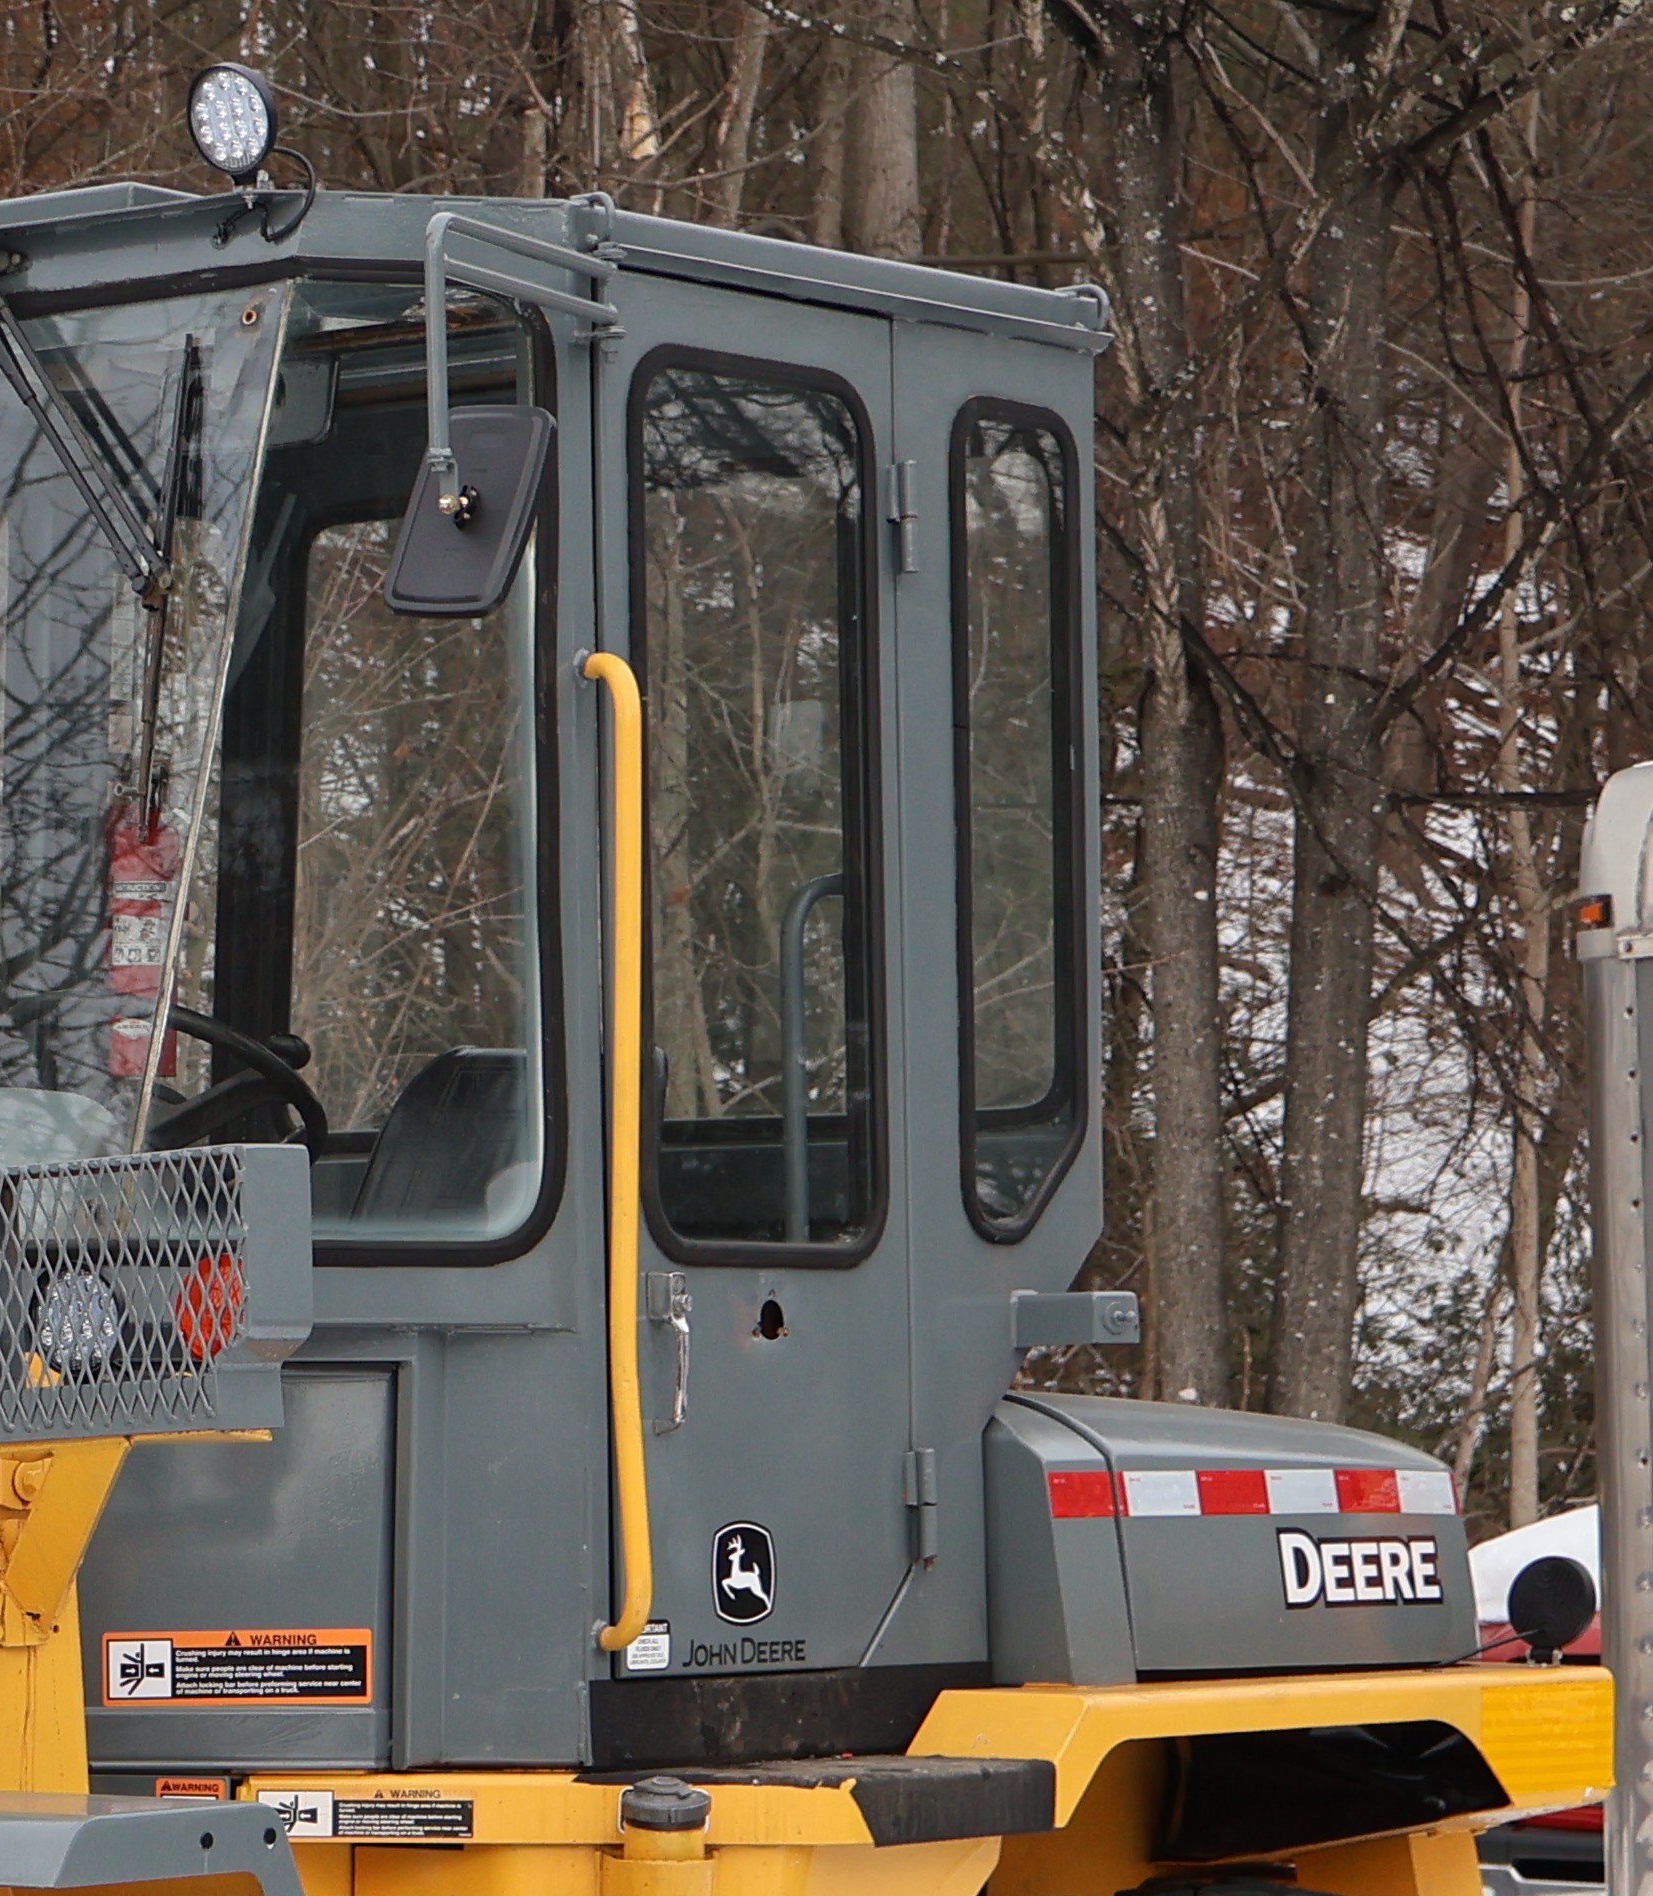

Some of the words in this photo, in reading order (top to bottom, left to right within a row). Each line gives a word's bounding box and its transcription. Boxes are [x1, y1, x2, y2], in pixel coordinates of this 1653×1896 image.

[1277, 1529, 1443, 1608] DEERE
[249, 1634, 317, 1645] WARNING
[682, 1639, 736, 1667] JOHN
[741, 1637, 806, 1664] DEERE
[172, 1783, 219, 1792] WARNING
[390, 1790, 441, 1798] WARNING
